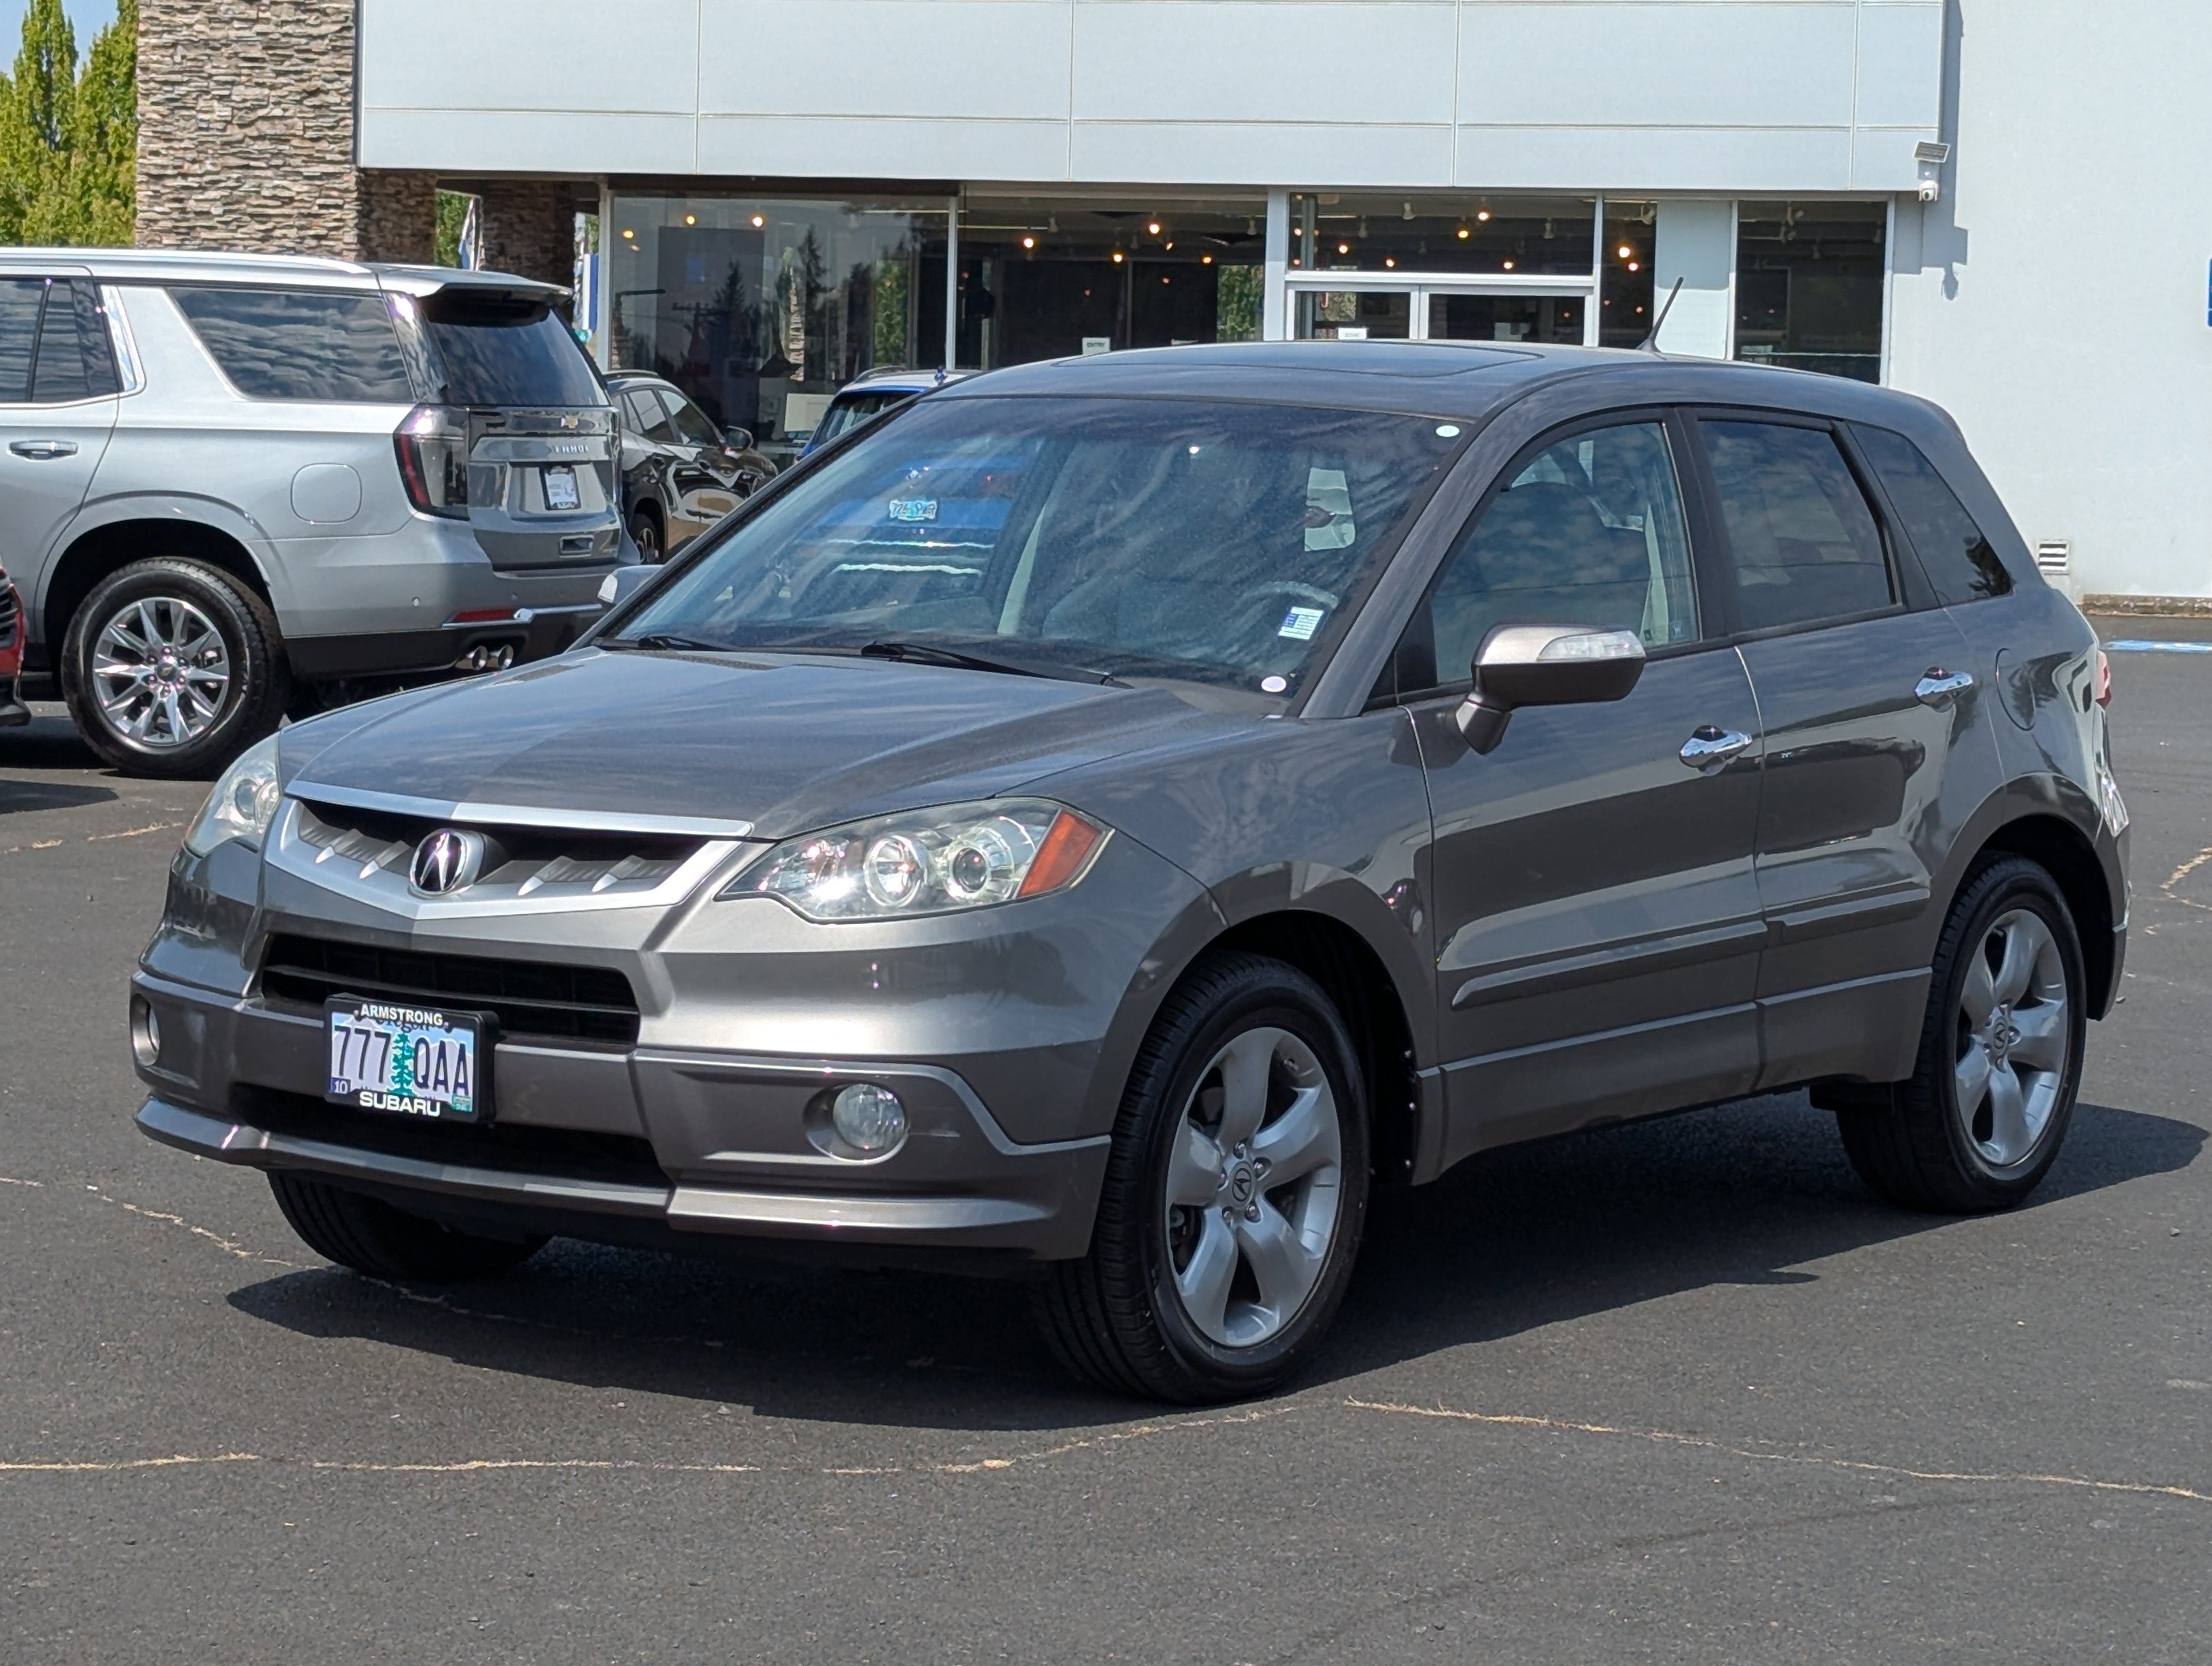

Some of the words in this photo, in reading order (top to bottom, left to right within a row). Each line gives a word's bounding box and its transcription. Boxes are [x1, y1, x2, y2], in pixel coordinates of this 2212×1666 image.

[361, 1003, 443, 1026] ARMSTRONG
[334, 1024, 391, 1084] 777
[413, 1036, 470, 1096] QAA
[334, 1080, 348, 1094] 10
[359, 1090, 441, 1117] SUBARU
